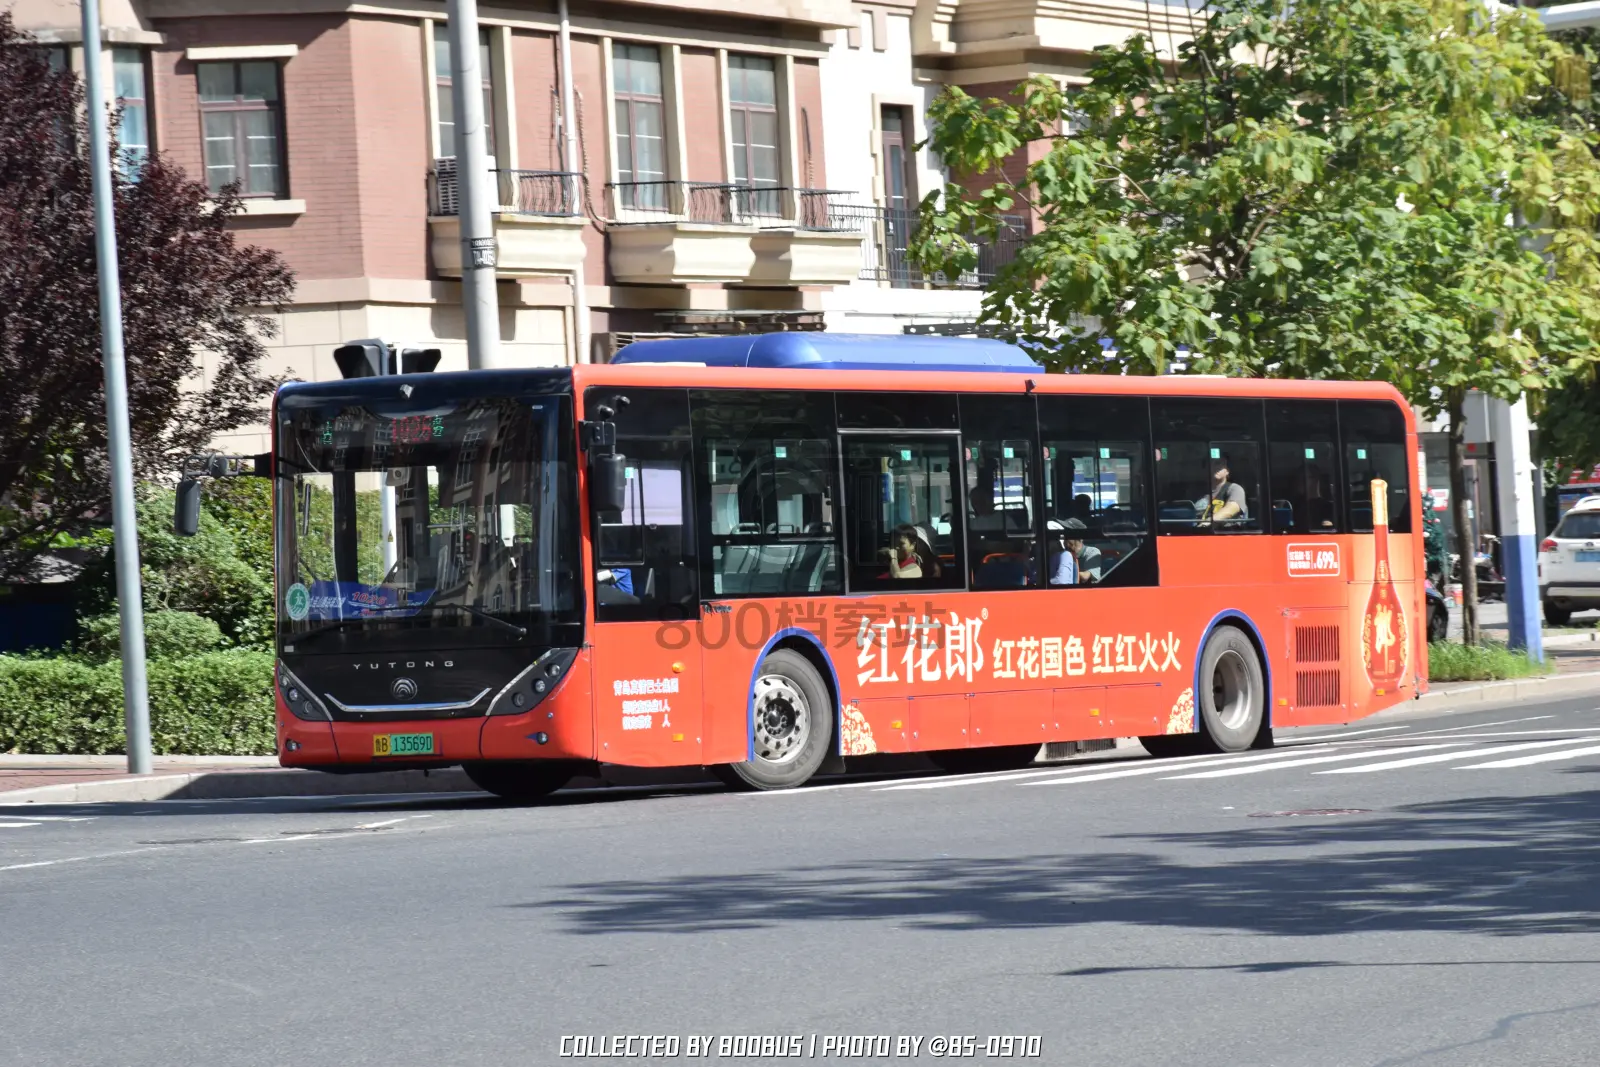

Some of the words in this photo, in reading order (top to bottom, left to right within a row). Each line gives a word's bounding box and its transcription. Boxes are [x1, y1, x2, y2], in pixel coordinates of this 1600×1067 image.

[353, 660, 454, 670] YUTONG
[857, 611, 984, 687] 红花郎
[992, 634, 1086, 680] 红花国色
[1092, 631, 1182, 674] 红红火火
